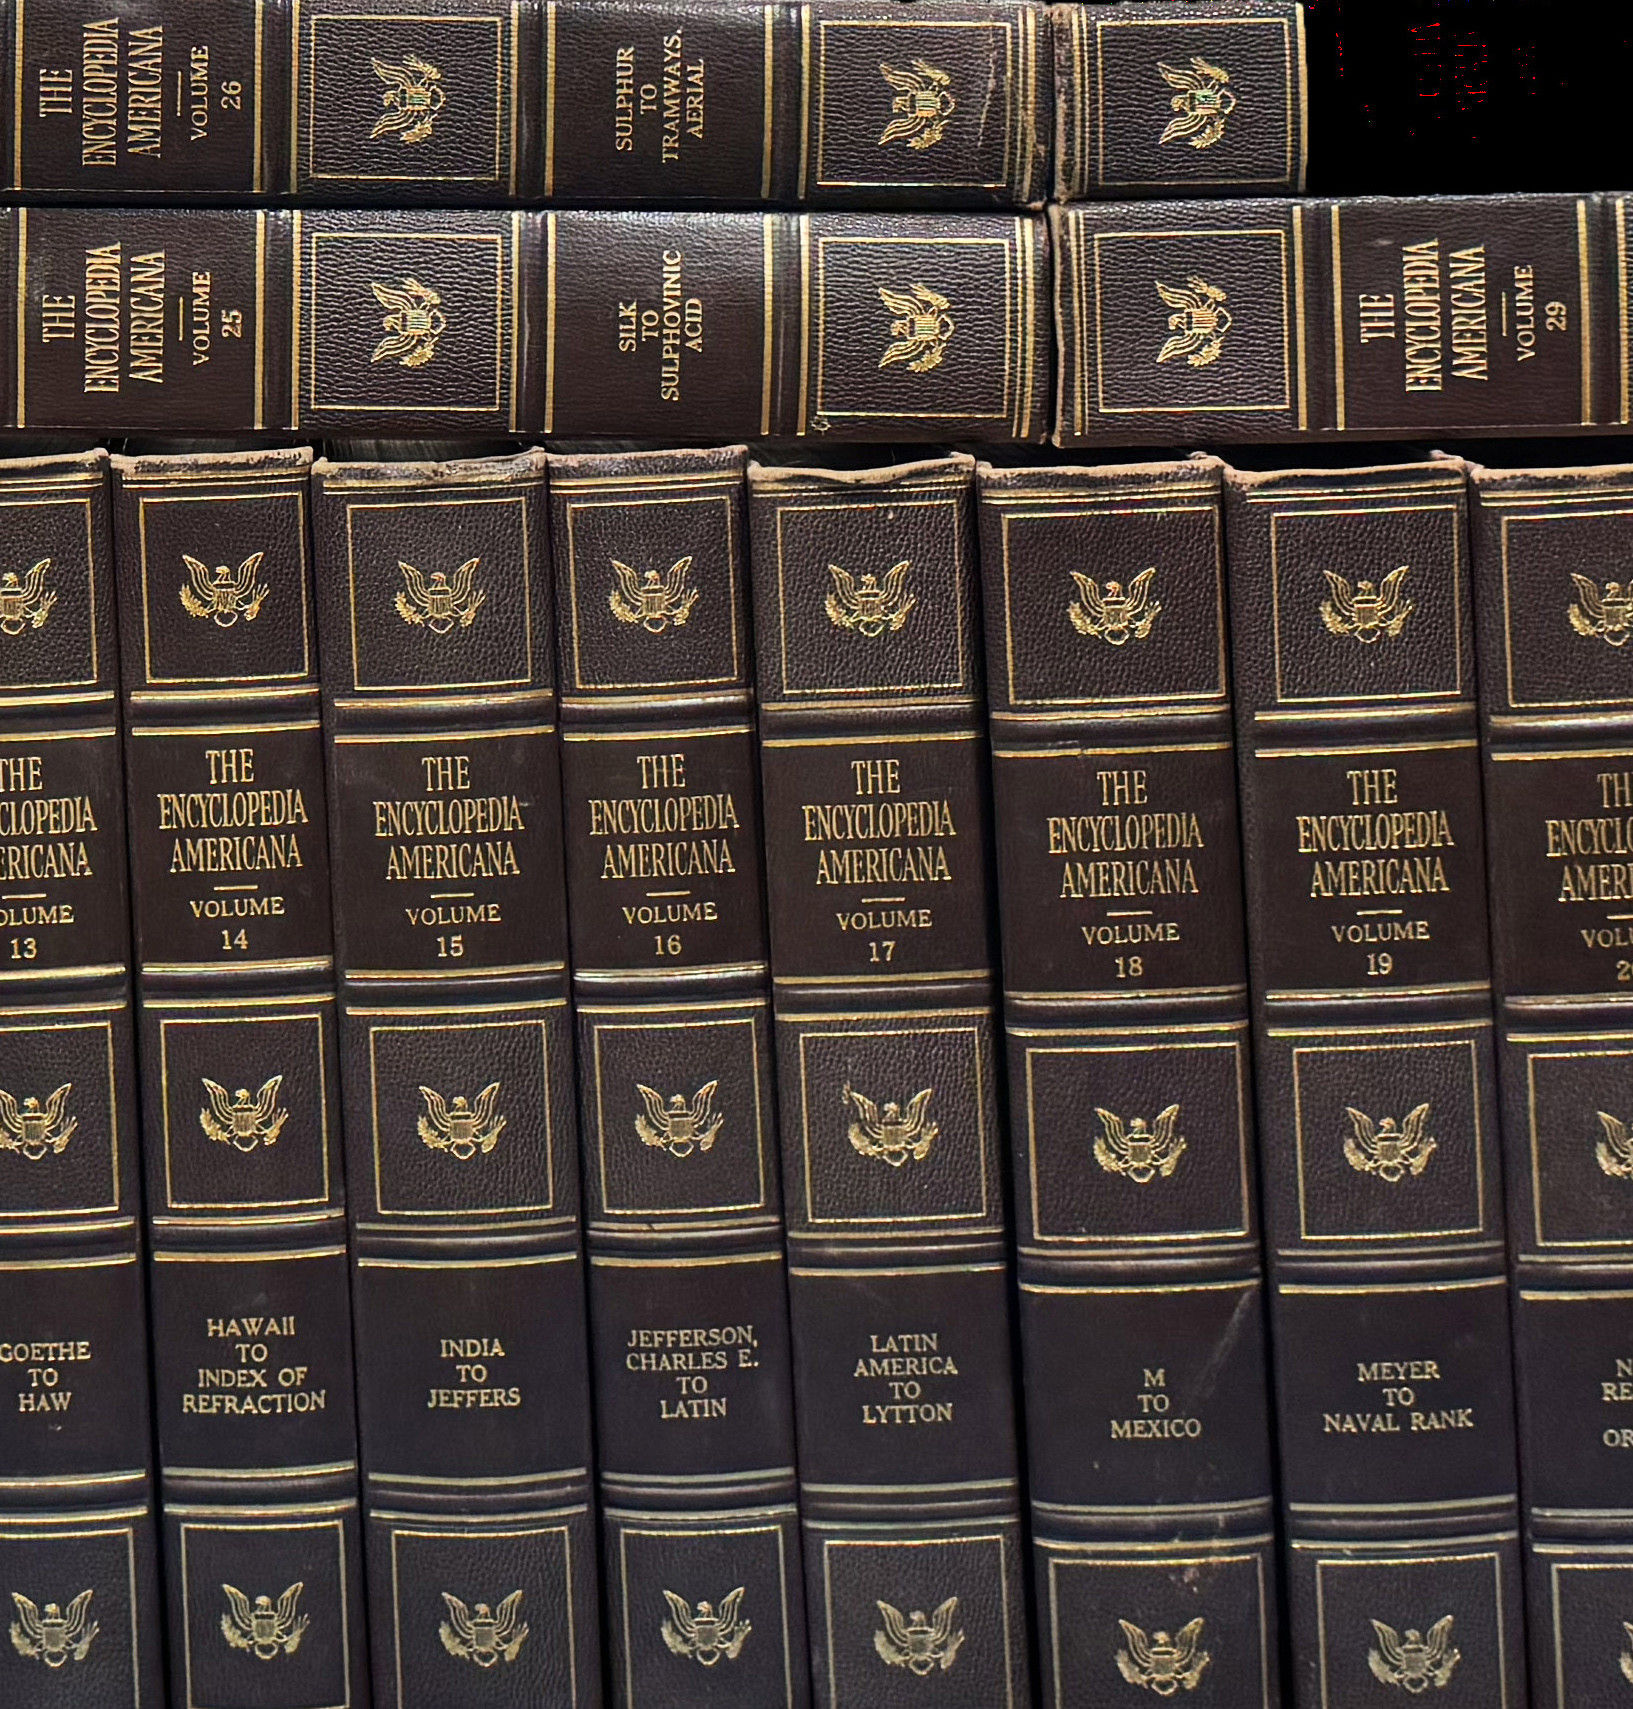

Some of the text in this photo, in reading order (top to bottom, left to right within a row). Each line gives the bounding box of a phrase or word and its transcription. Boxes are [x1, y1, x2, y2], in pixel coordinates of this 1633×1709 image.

[39, 68, 73, 118] THE
[81, 16, 120, 166] ENCYCLOPEDIA
[126, 25, 164, 159] AMERICANA
[189, 45, 209, 141] VOLUME
[220, 80, 242, 110] 26
[615, 45, 635, 151] SULPHUR
[639, 83, 658, 115] TO
[686, 58, 705, 139] AERIAL
[41, 294, 76, 343] THE
[83, 241, 122, 393] ENCYCLOPEDIA
[128, 249, 166, 384] AMERICANA
[191, 271, 211, 366] VOLUME
[221, 309, 243, 338] 25
[618, 300, 637, 352] SILK
[641, 309, 660, 342] TO
[660, 249, 685, 401] SULPHOVINIC
[684, 297, 703, 353] ACID
[1358, 293, 1396, 344] THE
[1401, 237, 1442, 392] ENCYCLOPEDIA
[1448, 244, 1489, 381] AMERICANA
[1513, 264, 1536, 362] VOLUME
[1544, 301, 1567, 331] 29
[421, 755, 471, 792] THE
[850, 759, 901, 796] THE
[1096, 770, 1148, 806] THE
[1346, 768, 1398, 806] THE
[156, 788, 309, 830] ENCYCLOPEDIA
[372, 795, 524, 837] ENCYCLOPEDIA
[587, 793, 740, 836] ENCYCLOPEDIA
[801, 799, 957, 842] ENCYCLOPEDIA
[1046, 812, 1205, 854] ENCYCLOPEDIA
[1295, 809, 1455, 853] ENCYCLOPEDIA
[169, 833, 303, 874] AMERICANA
[385, 840, 521, 881] AMERICANA
[600, 838, 736, 879] AMERICANA
[815, 845, 952, 885] AMERICANA
[1059, 858, 1199, 899] AMERICANA
[1310, 856, 1451, 898] AMERICANA
[189, 896, 285, 918] VOLUME
[405, 903, 502, 926] VOLUME
[621, 901, 718, 925] VOLUME
[835, 908, 933, 931] VOLUME
[221, 928, 249, 950] 14
[436, 934, 464, 958] 15
[654, 934, 682, 956] 16
[1081, 922, 1181, 945] VOLUME
[1331, 920, 1431, 943] VOLUME
[10, 937, 37, 959] 13
[868, 940, 896, 962] 17
[1114, 955, 1143, 979] 18
[1367, 952, 1393, 976] 19
[206, 1315, 296, 1338] HAWAII
[627, 1324, 758, 1348] JEFFERSON,
[234, 1343, 268, 1363] TO
[440, 1337, 506, 1358] INDIA
[869, 1332, 938, 1353] LATIN
[626, 1348, 759, 1372] CHARLES E.
[853, 1356, 959, 1378] AMERICA
[1356, 1360, 1441, 1383] MEYER
[198, 1366, 308, 1388] INDEX OF
[675, 1375, 708, 1395] TO
[888, 1380, 922, 1400] TO
[1143, 1368, 1166, 1388] M
[18, 1391, 72, 1413] HAW
[182, 1389, 326, 1415] REFRACTION
[427, 1387, 521, 1409] JEFFERS
[659, 1397, 727, 1419] LATIN
[1137, 1393, 1170, 1413] TO
[1382, 1386, 1415, 1407] TO
[862, 1402, 953, 1424] LYTTON
[1322, 1407, 1474, 1433] NAVAL RANK
[1110, 1418, 1202, 1439] MEXICO
